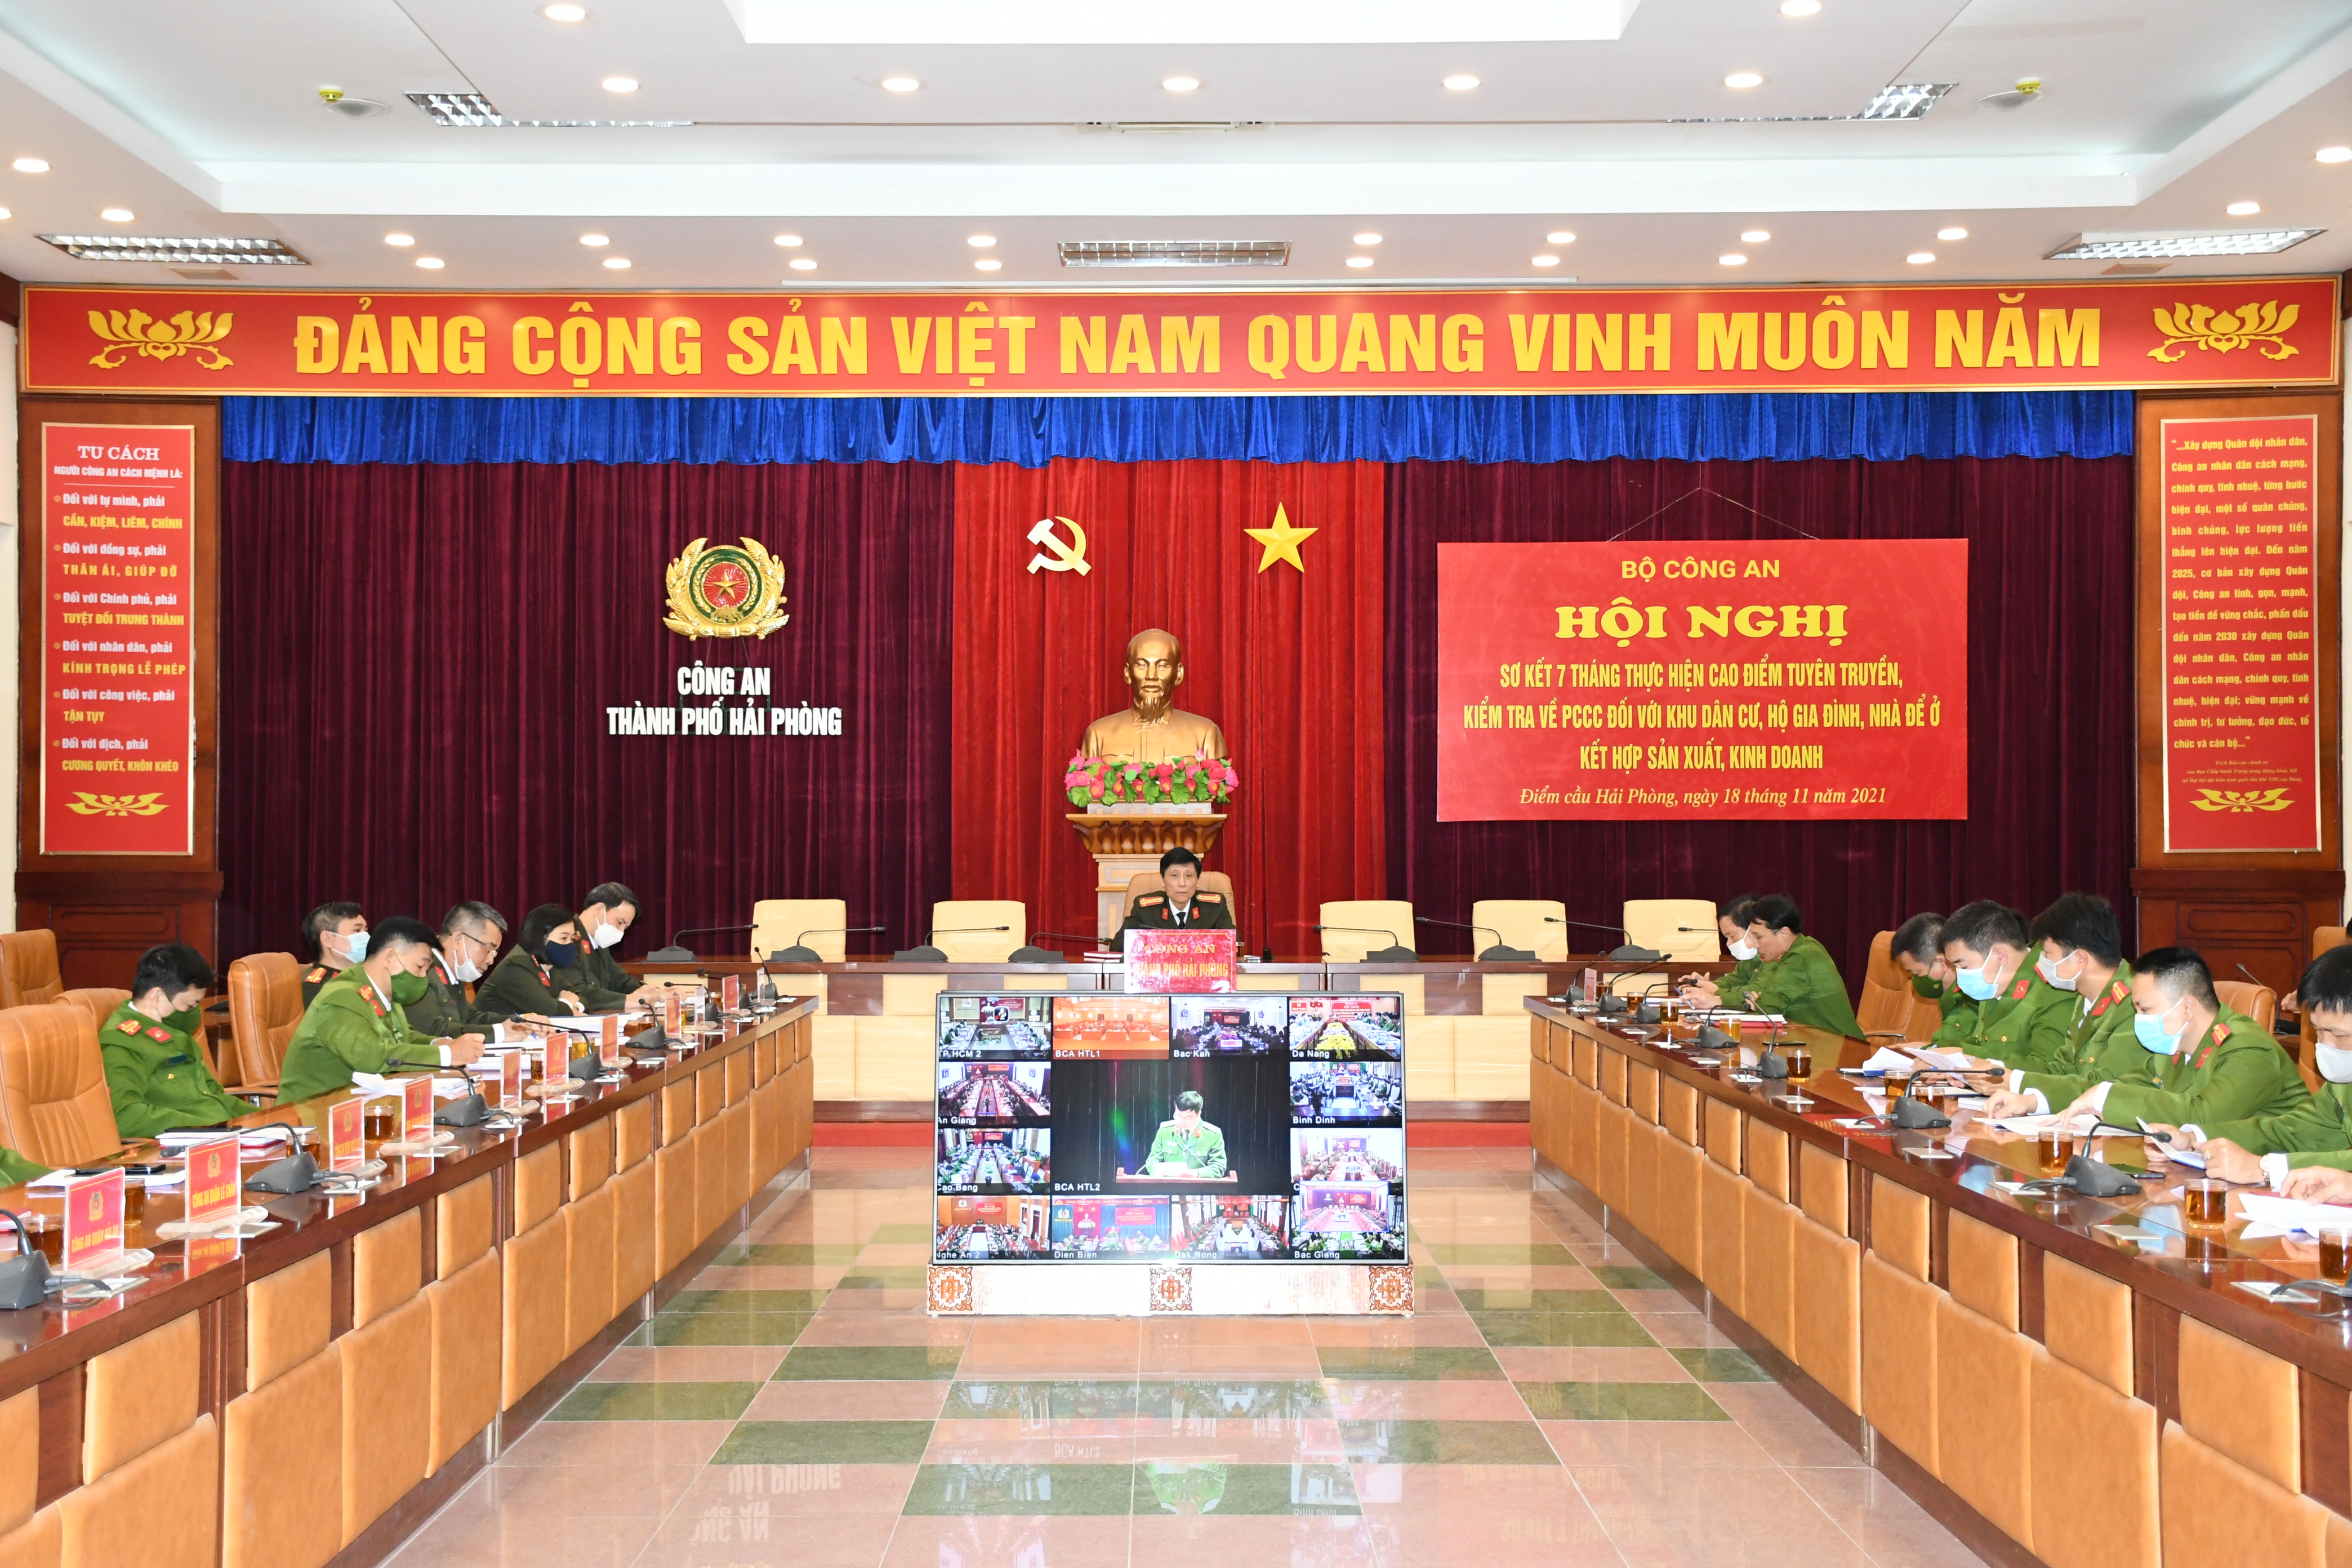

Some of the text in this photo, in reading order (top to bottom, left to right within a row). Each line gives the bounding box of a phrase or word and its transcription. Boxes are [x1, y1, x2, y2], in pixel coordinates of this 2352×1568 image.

[294, 293, 2101, 388] ĐẢNG CỘNG SẢN VIỆT NAM QUANG VINH MUÔN NĂM
[108, 444, 159, 460] CÁCH
[106, 468, 118, 476] AN
[1622, 556, 1779, 582] BỘ CÔNG AN
[2172, 569, 2195, 578] 2025,
[1555, 596, 1847, 647] HỘI NGHỊ
[2216, 632, 2237, 640] 2030
[678, 661, 769, 695] CÔNG AN
[1500, 654, 1902, 691] SƠ KẾT 7 THÁNG THỰC HIỆN CAO ĐIỂM TUYÊN TRUYỀN,
[607, 697, 841, 735] THÀNH PHỐ HẢI PHÒNG
[1464, 694, 1940, 732] KIỂM TRA VỀ PCCC ĐỐI VỚI KHU DÂN CƯ, HỘ GIA ĐÌNH, NHÀ ĐỂ Ở
[1580, 737, 1823, 774] KẾT HỢP SẢN XUẤT, KINH DOANH
[1520, 785, 1885, 807] Điểm cầu Hải Phòng, ngày 18 tháng 11 năm 2021
[1193, 945, 1216, 954] AN
[1183, 957, 1196, 977] HẢI
[1307, 1050, 1330, 1059] Nang
[951, 1116, 977, 1125] Giang
[956, 1184, 978, 1192] Bang
[1195, 1251, 1217, 1259] Nong
[1314, 1250, 1340, 1259] Giang
